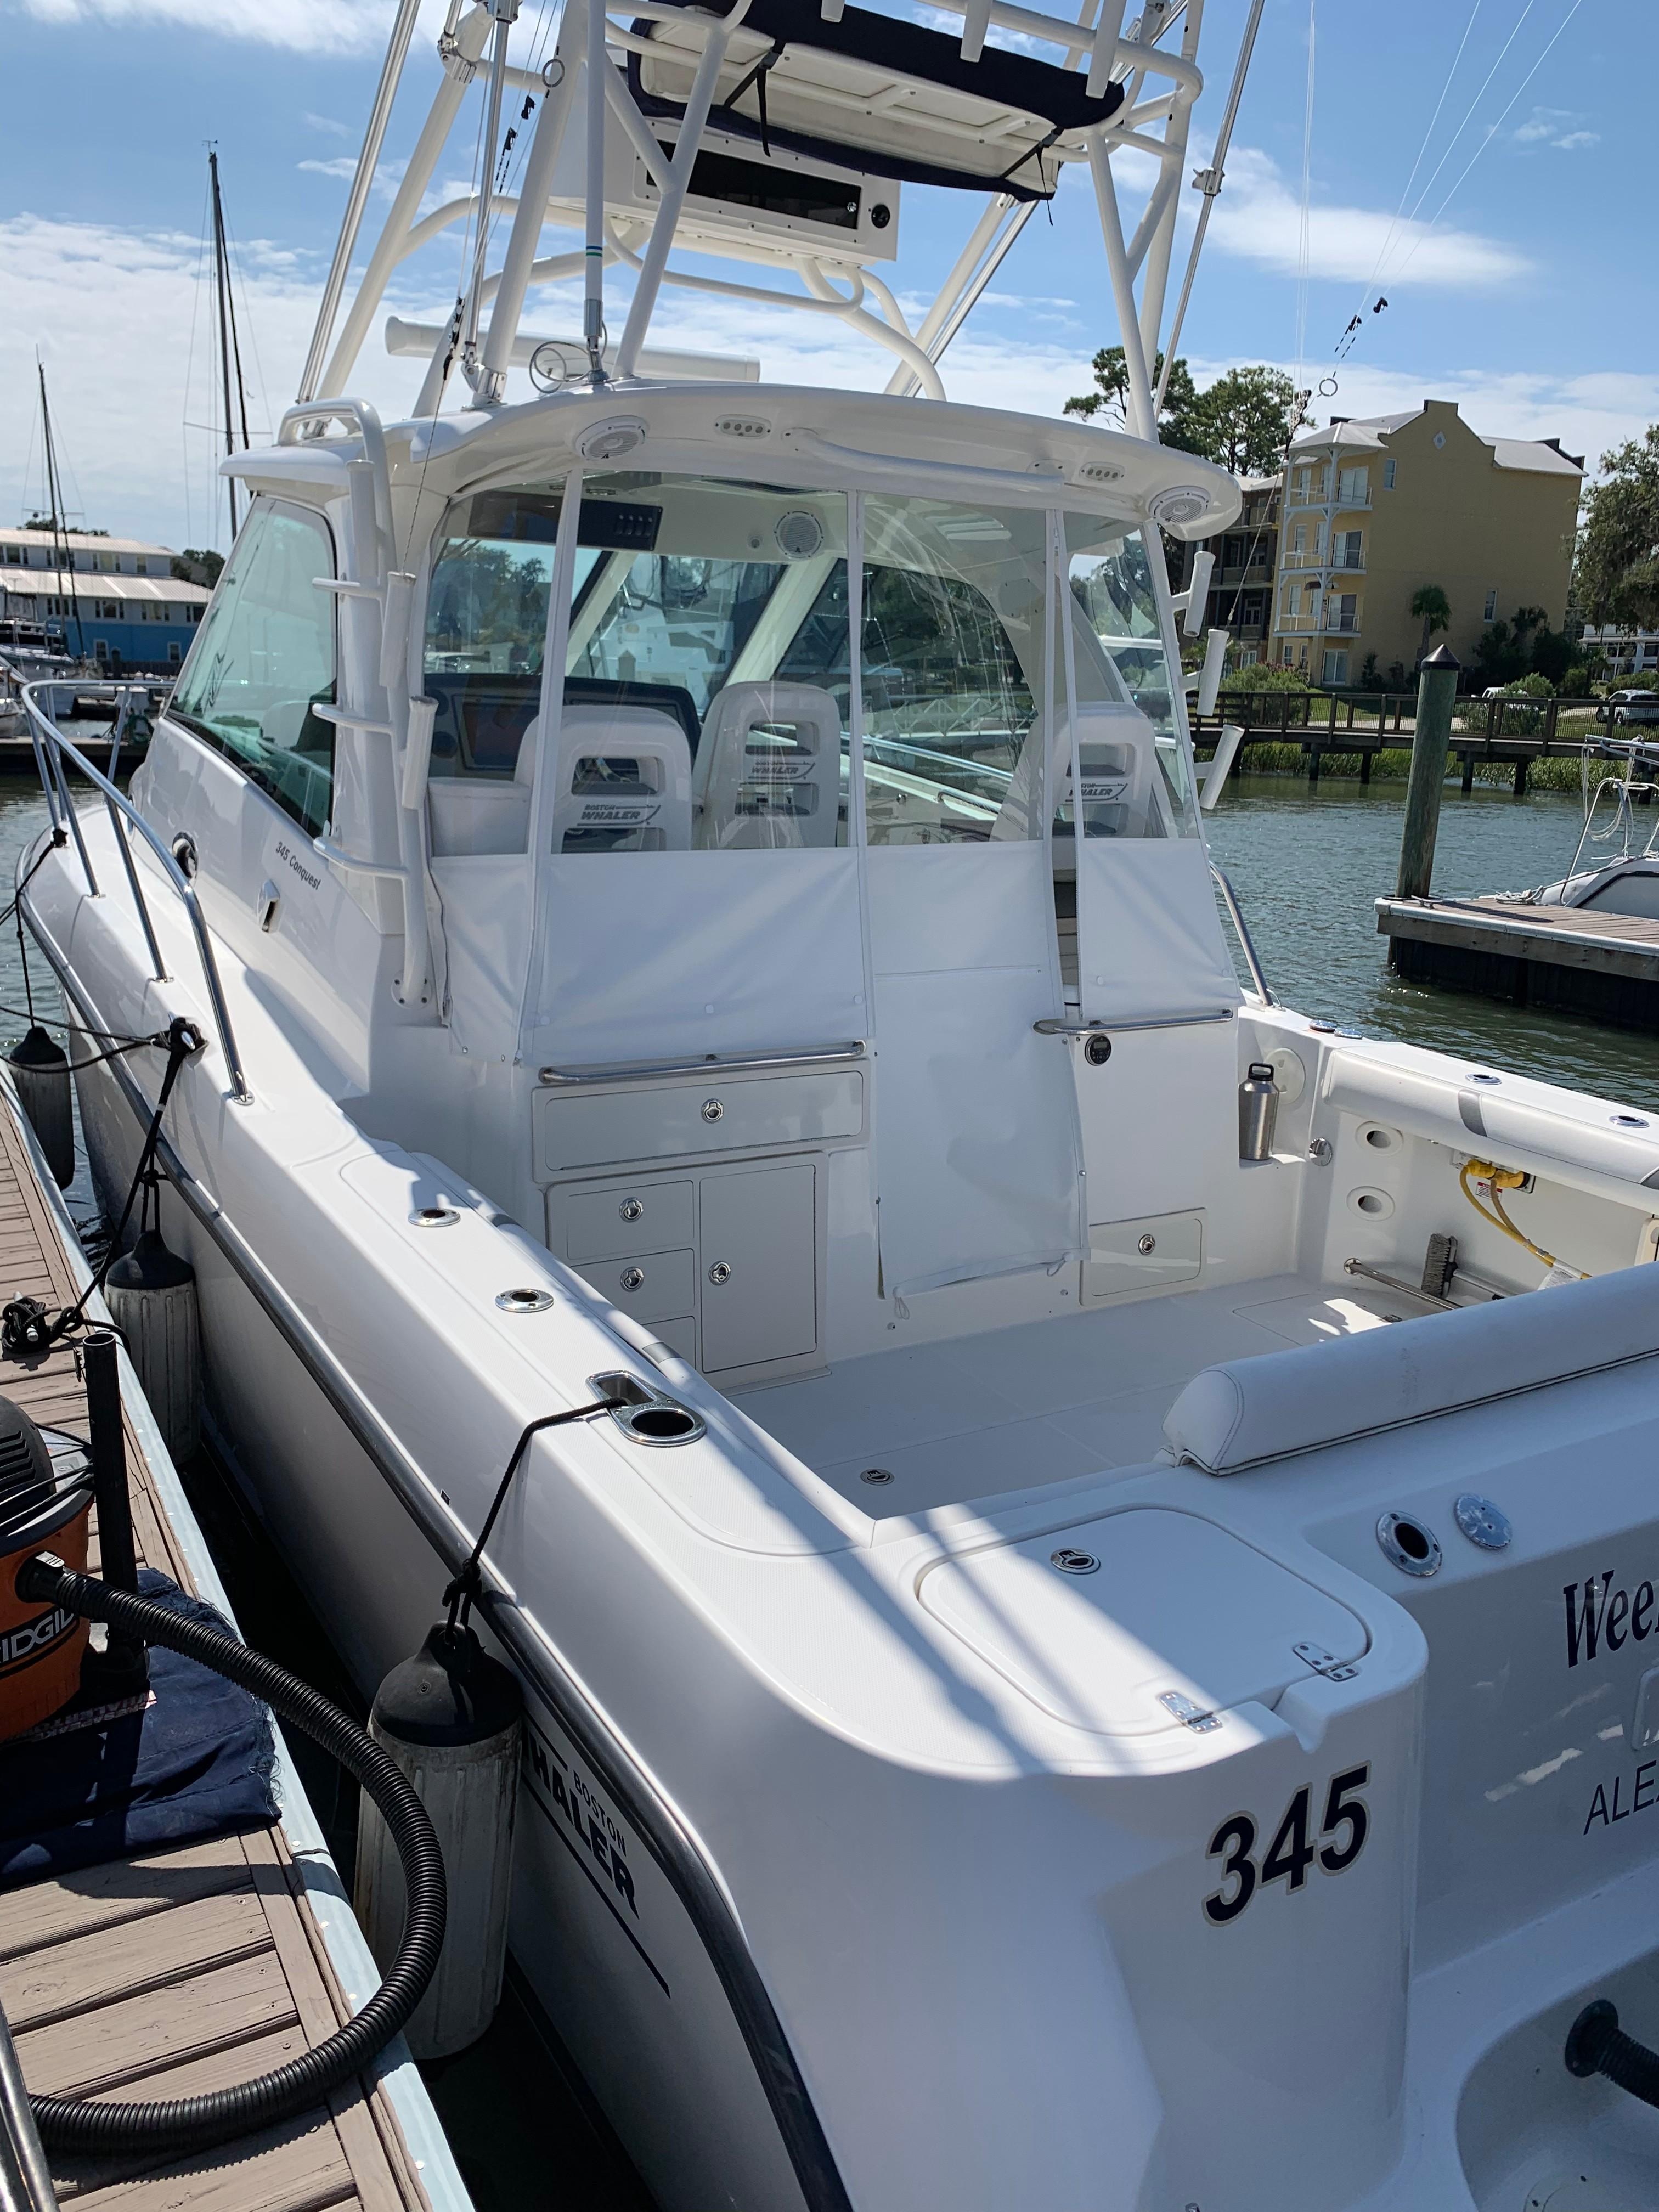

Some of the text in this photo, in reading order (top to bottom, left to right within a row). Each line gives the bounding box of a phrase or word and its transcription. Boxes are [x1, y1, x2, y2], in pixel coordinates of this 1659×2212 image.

[581, 811, 641, 820] WHALER
[276, 842, 321, 890] 345 Conquest
[0, 1605, 74, 1662] IDGID
[1564, 1570, 1659, 1668] Wee
[524, 1724, 640, 1920] HALER
[573, 1769, 627, 1857] BOSTON
[1583, 1760, 1659, 1836] ALE
[1201, 1760, 1370, 1927] 345
